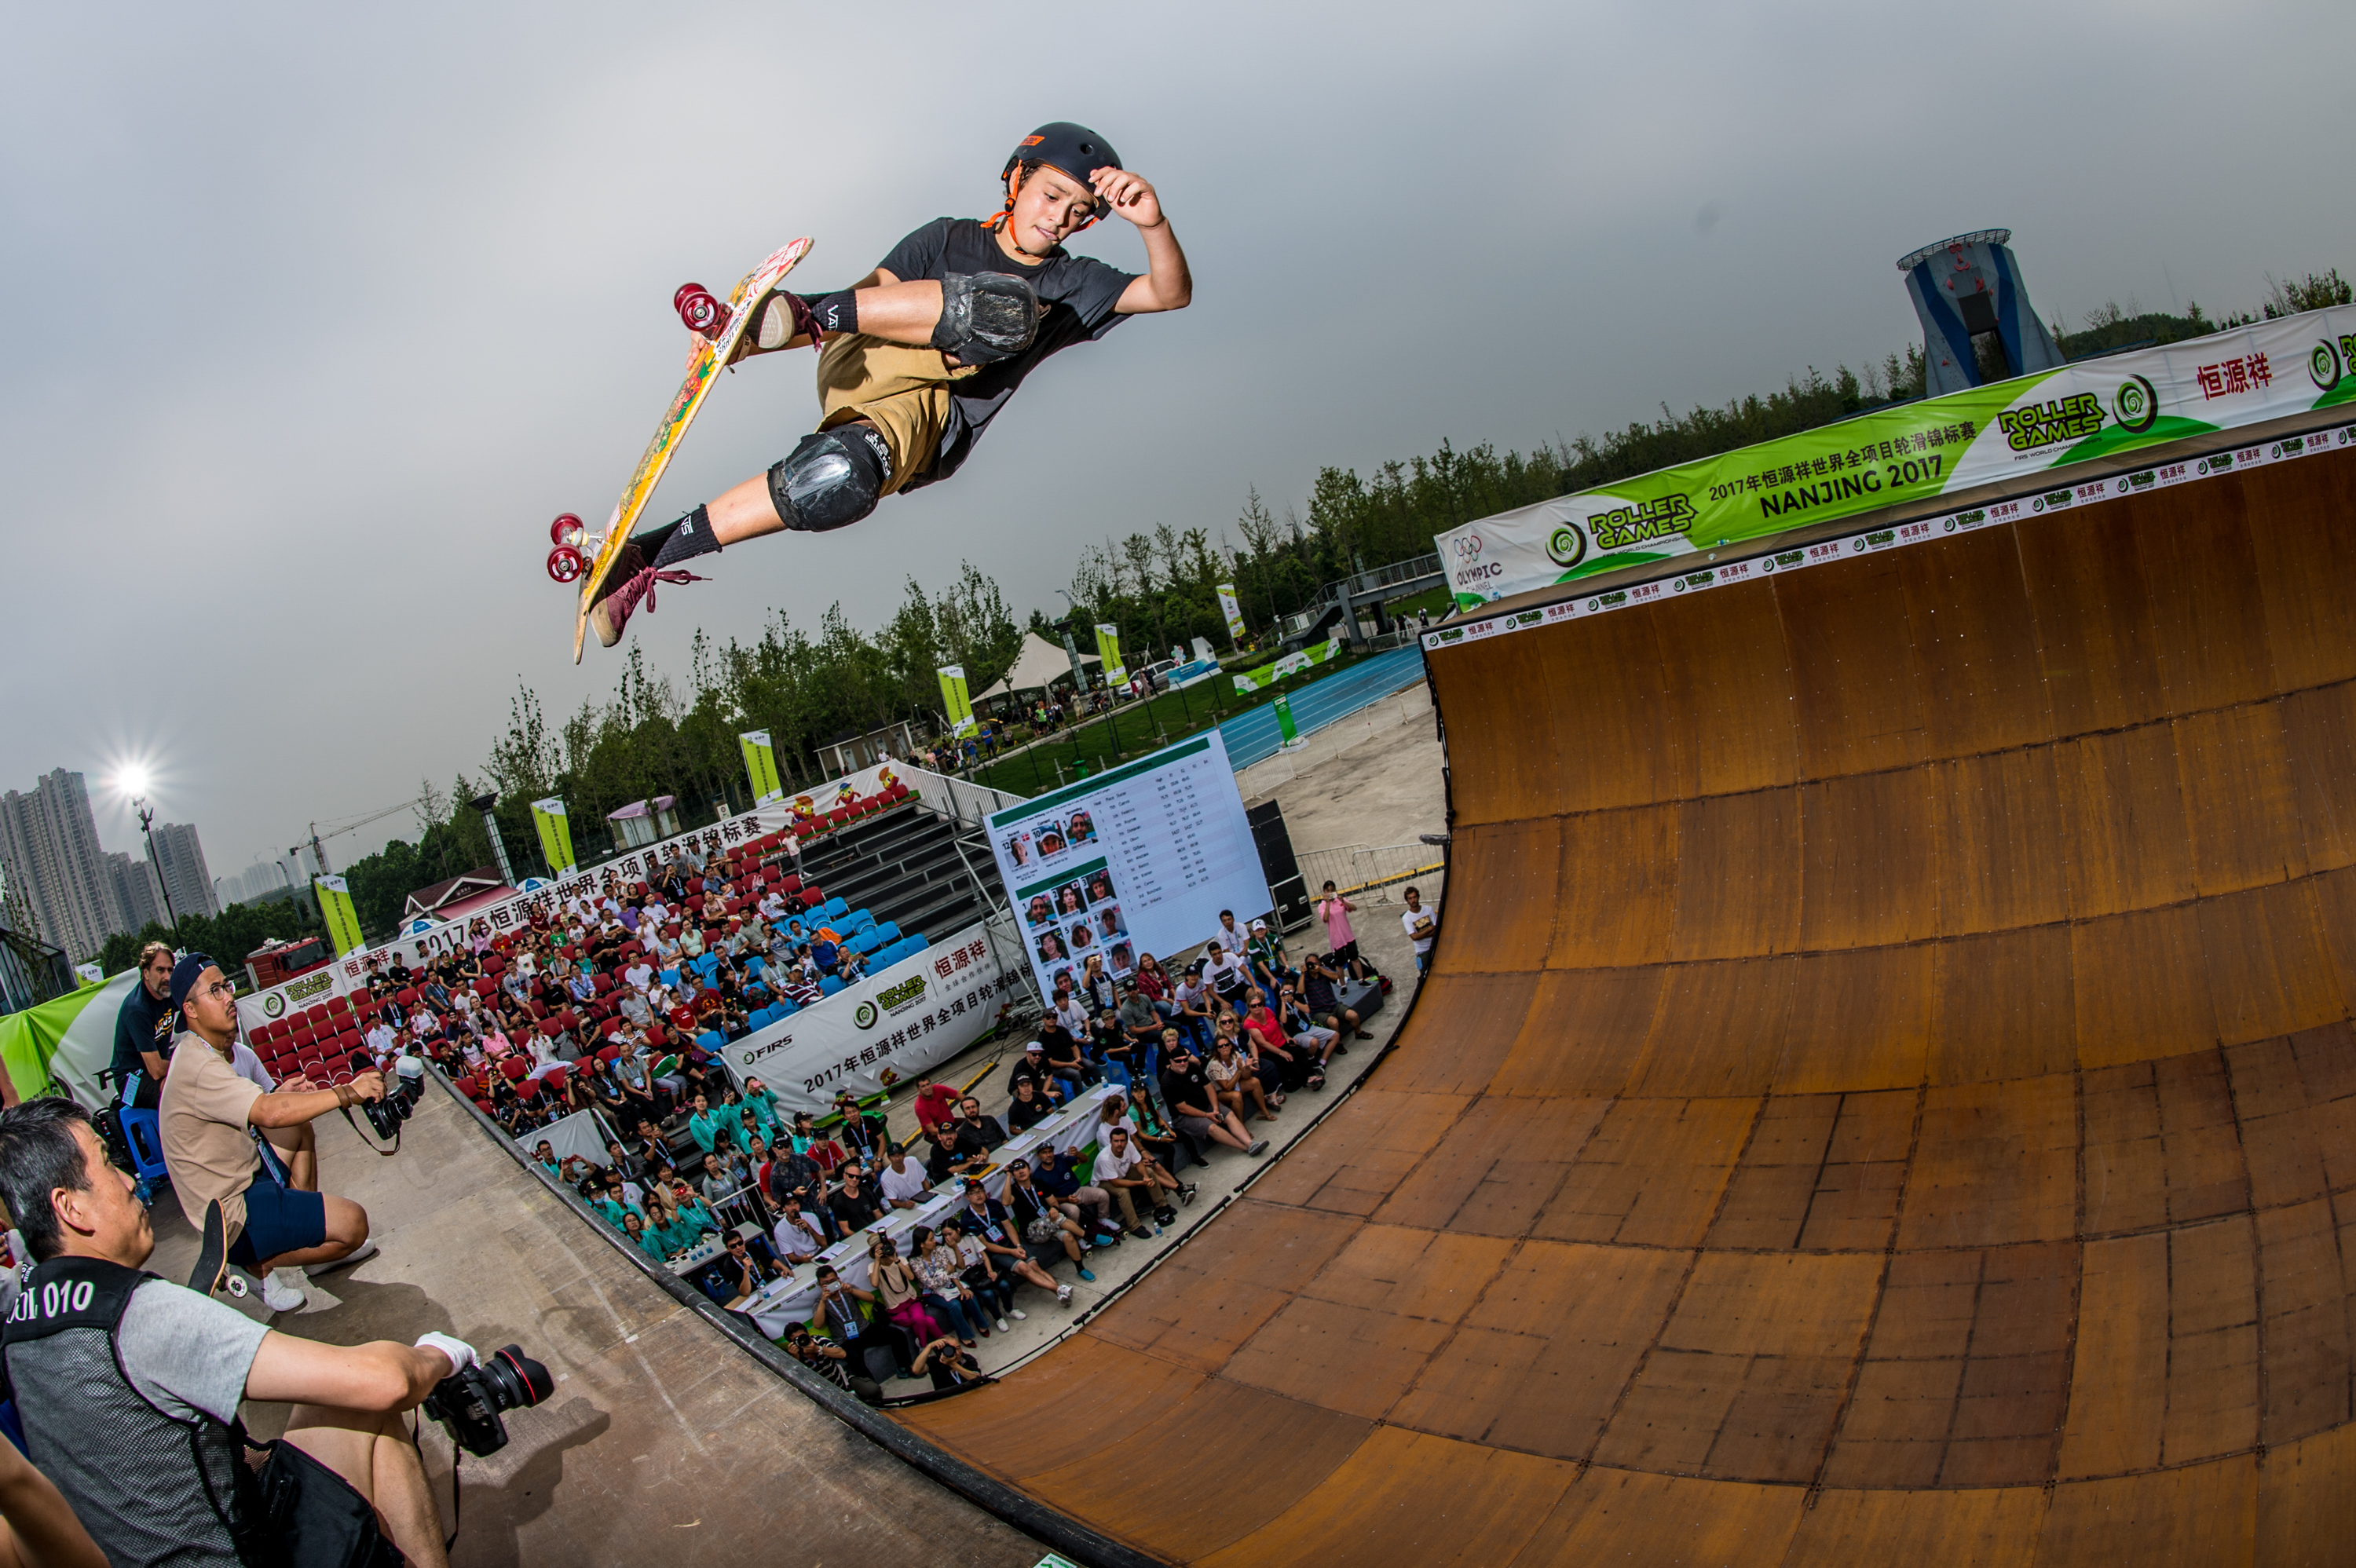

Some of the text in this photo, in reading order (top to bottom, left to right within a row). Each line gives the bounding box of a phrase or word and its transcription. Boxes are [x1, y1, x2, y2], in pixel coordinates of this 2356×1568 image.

[2197, 352, 2273, 400] 恒源祥
[1997, 392, 2109, 434] ROLLER
[2007, 417, 2102, 451] GAMES
[2307, 433, 2329, 448] 恒源祥
[2029, 448, 2052, 458] WORLD
[2053, 437, 2102, 453] CHAMPIONSHIPS
[2237, 448, 2261, 463] 恒源祥
[1708, 421, 1976, 501] 2017年恒源祥世界全项目轮滑锦标赛
[2160, 464, 2186, 481] 恒源祥
[1760, 455, 1943, 518] NANJING 2017
[2077, 483, 2105, 499] 恒源祥
[1587, 493, 1699, 535] ROLLER
[1990, 502, 2019, 518] 恒源祥
[1597, 516, 1692, 550] GAMES
[1901, 522, 1930, 539] 恒源祥
[1617, 546, 1640, 555] WORLD
[1641, 533, 1692, 549] CHAMPIONSHIPS
[1809, 543, 1839, 558] 恒源祥
[1457, 562, 1502, 586] OLYMPIC
[1720, 563, 1748, 579] 恒源祥
[1466, 582, 1494, 594] CHANNEL
[1632, 583, 1660, 598] 恒源祥
[1547, 603, 1575, 618] 恒源祥
[1468, 621, 1494, 635] 恒源祥
[1032, 829, 1041, 839] 10
[1001, 841, 1010, 850] 12
[934, 936, 986, 980] 恒源祥
[284, 972, 334, 996] ROLLER
[944, 963, 991, 992] 全球合作伙伴
[290, 981, 331, 1002] GAMES
[876, 974, 927, 1004] ROLLER
[881, 985, 924, 1011] GAMES
[298, 992, 333, 1009] NANJING 2017
[890, 996, 927, 1018] NANJING 2017
[755, 1033, 792, 1058] FIRS
[43, 1280, 95, 1318] 010
